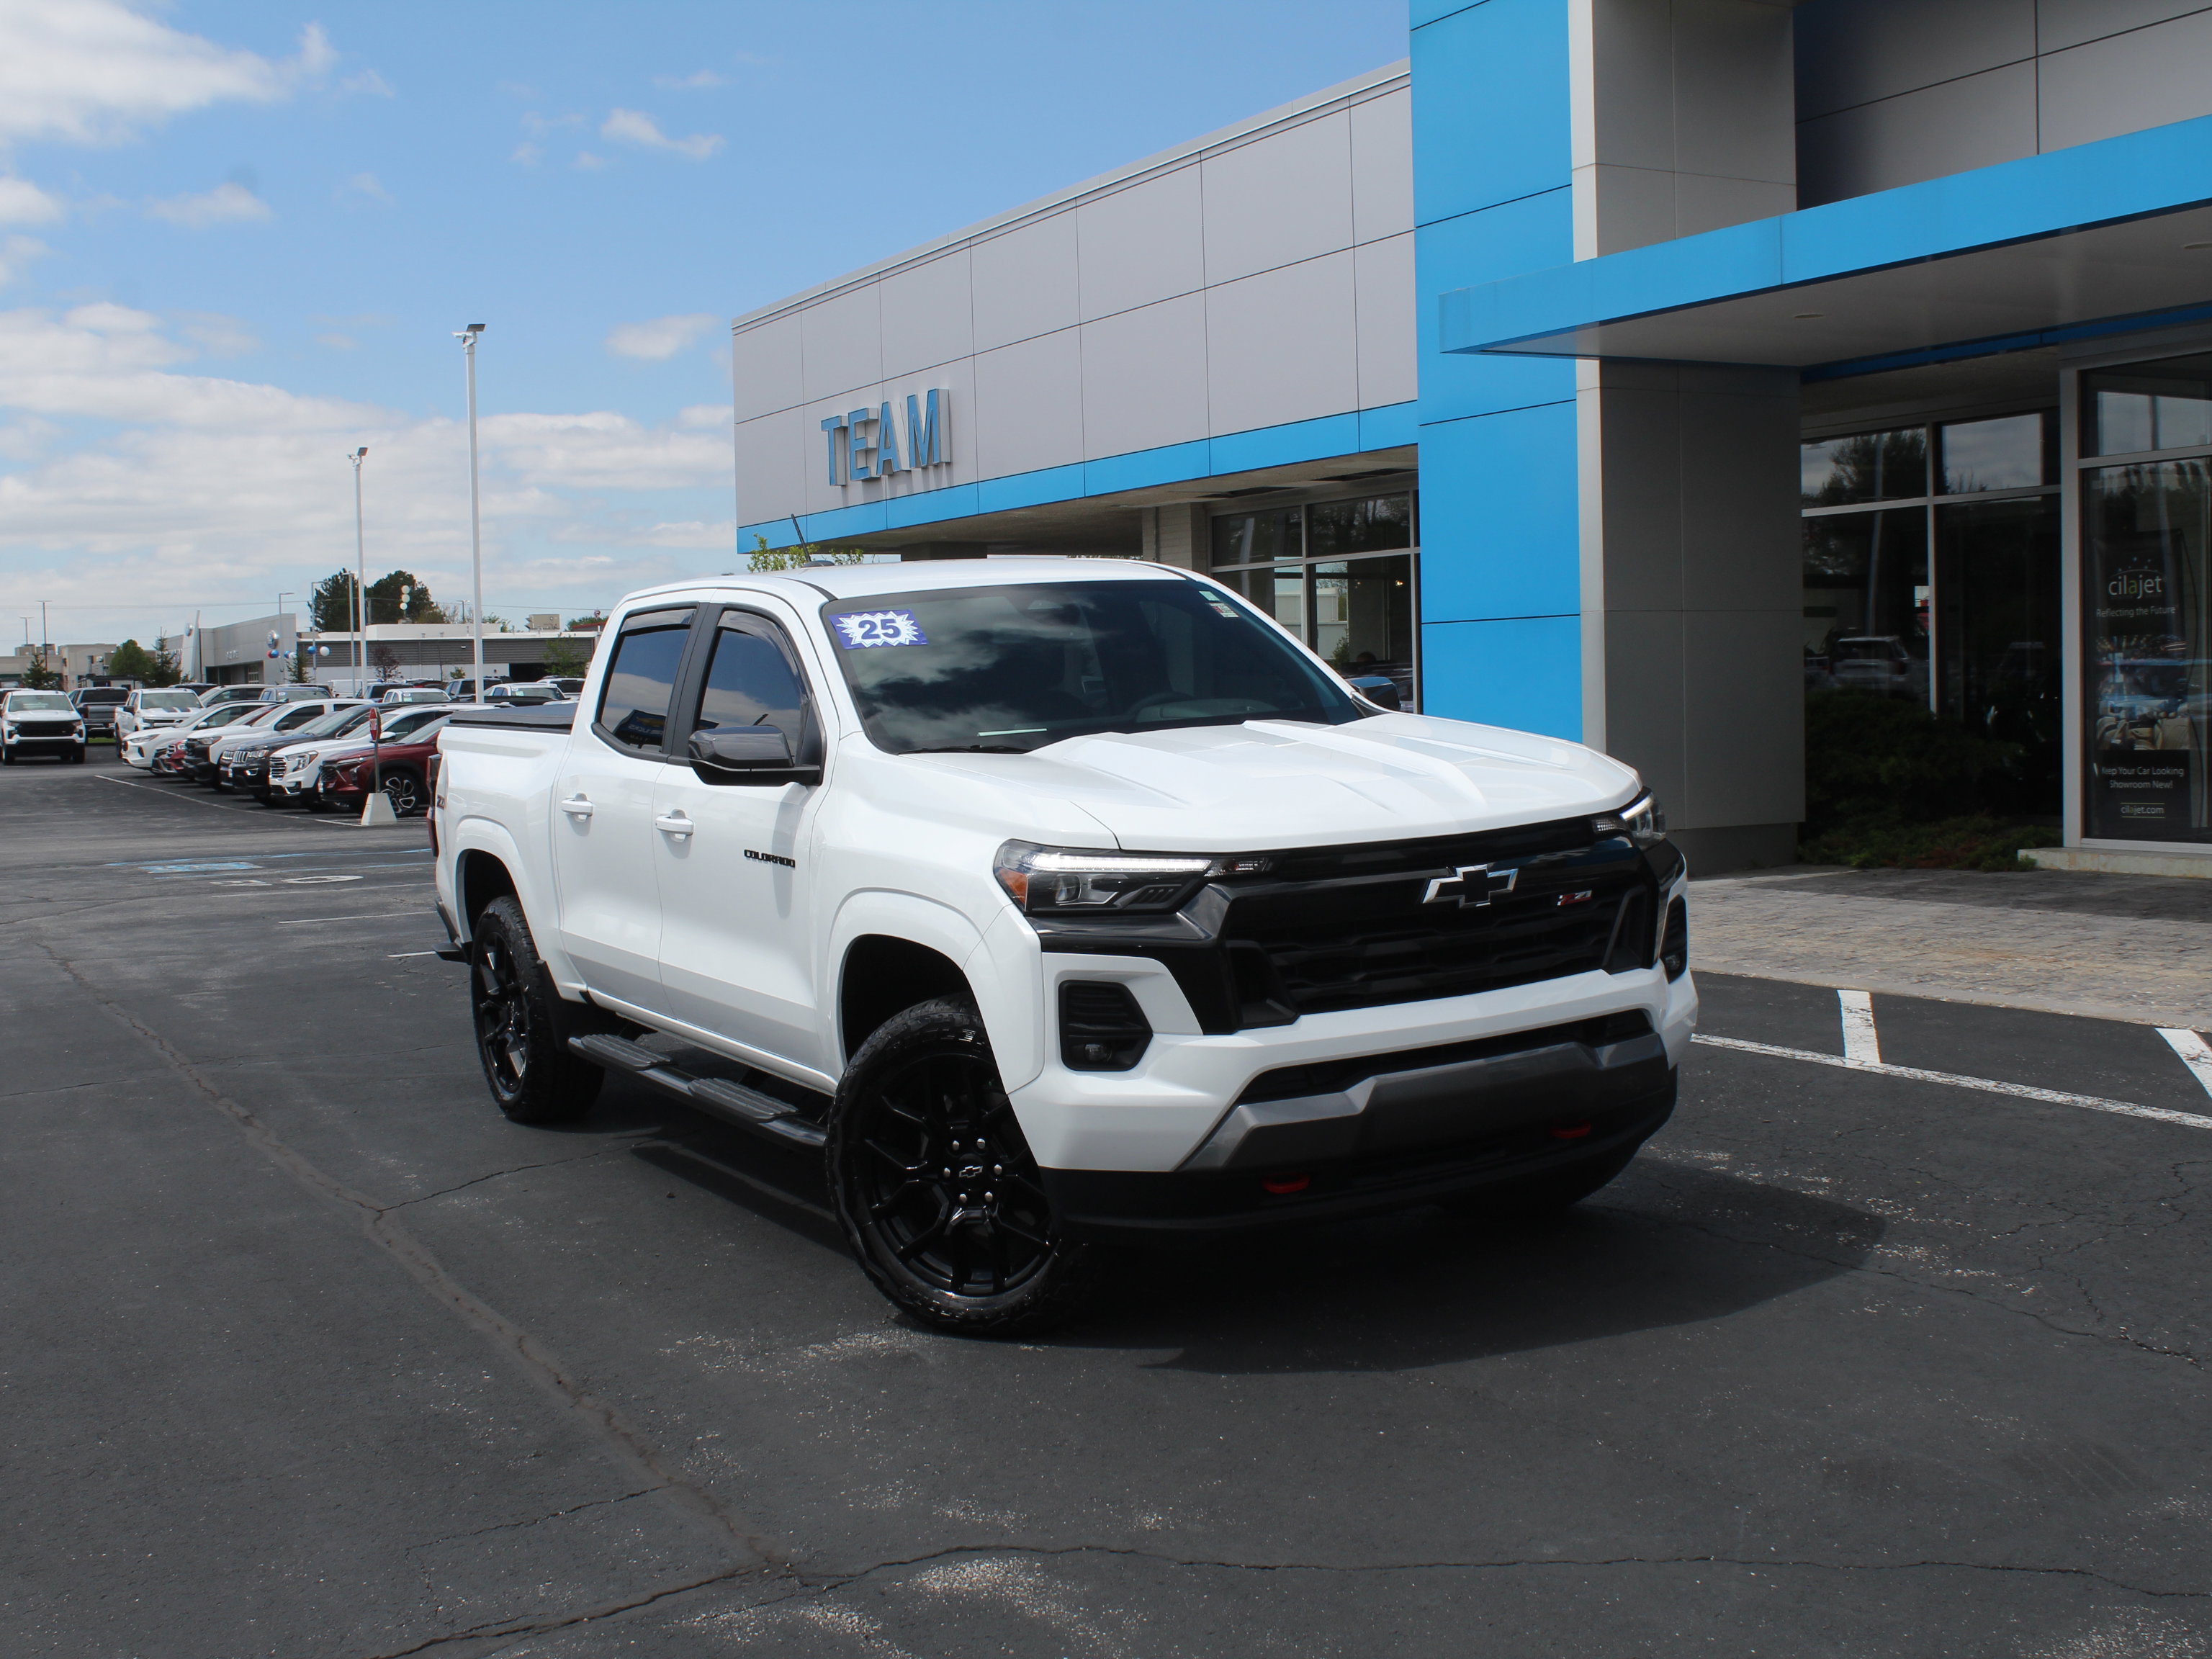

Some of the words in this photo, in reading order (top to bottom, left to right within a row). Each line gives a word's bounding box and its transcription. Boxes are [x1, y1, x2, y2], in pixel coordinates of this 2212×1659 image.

[821, 389, 950, 486] TEAM
[2108, 574, 2162, 599] cilajet
[2096, 608, 2134, 618] Reflecting
[2136, 606, 2149, 616] the
[2150, 605, 2175, 615] Future
[858, 619, 902, 639] 25
[2101, 766, 2117, 776] Keep
[2118, 766, 2135, 775] Your
[2137, 766, 2150, 775] Car
[2152, 766, 2185, 777] Looking
[2109, 780, 2151, 788] Showroom
[2152, 780, 2173, 788] New!
[2121, 805, 2164, 815] cilajet.com
[744, 849, 796, 868] COLORADO
